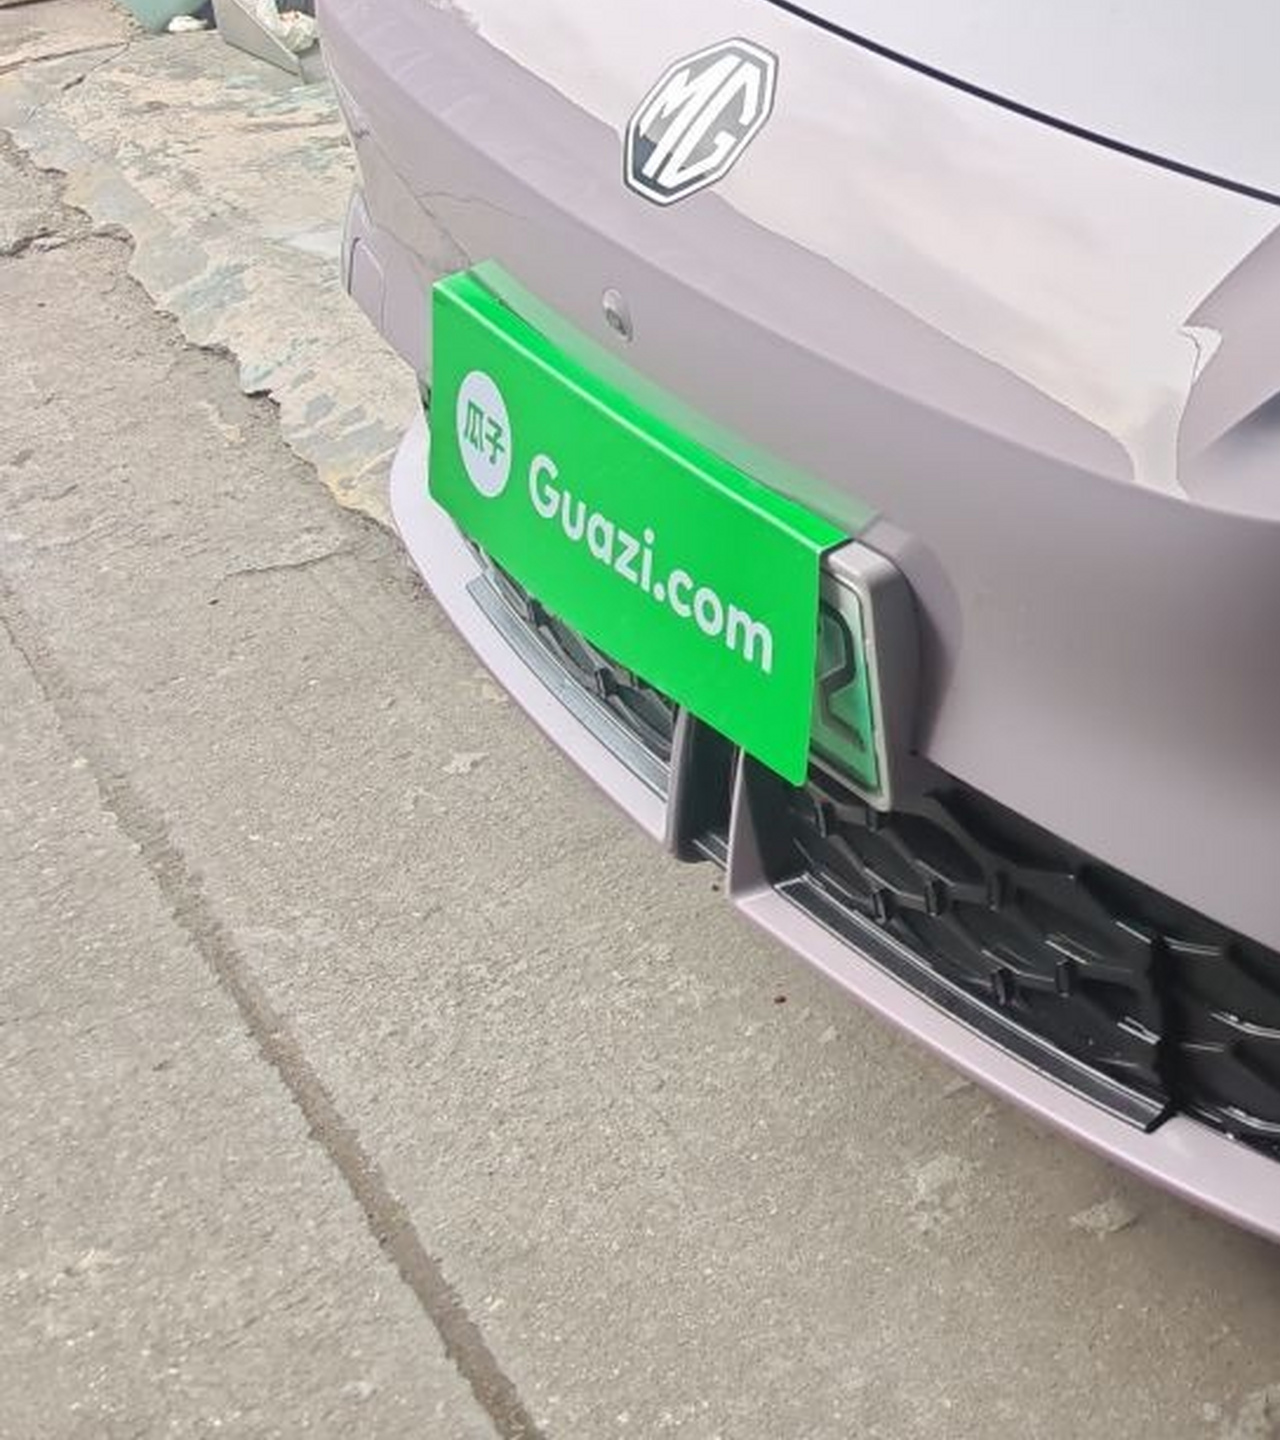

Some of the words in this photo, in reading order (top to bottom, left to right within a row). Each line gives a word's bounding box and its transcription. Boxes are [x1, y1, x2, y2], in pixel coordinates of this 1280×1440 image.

[639, 53, 761, 188] MG
[464, 400, 505, 464] 瓜子
[529, 454, 773, 672] Guazi.com
